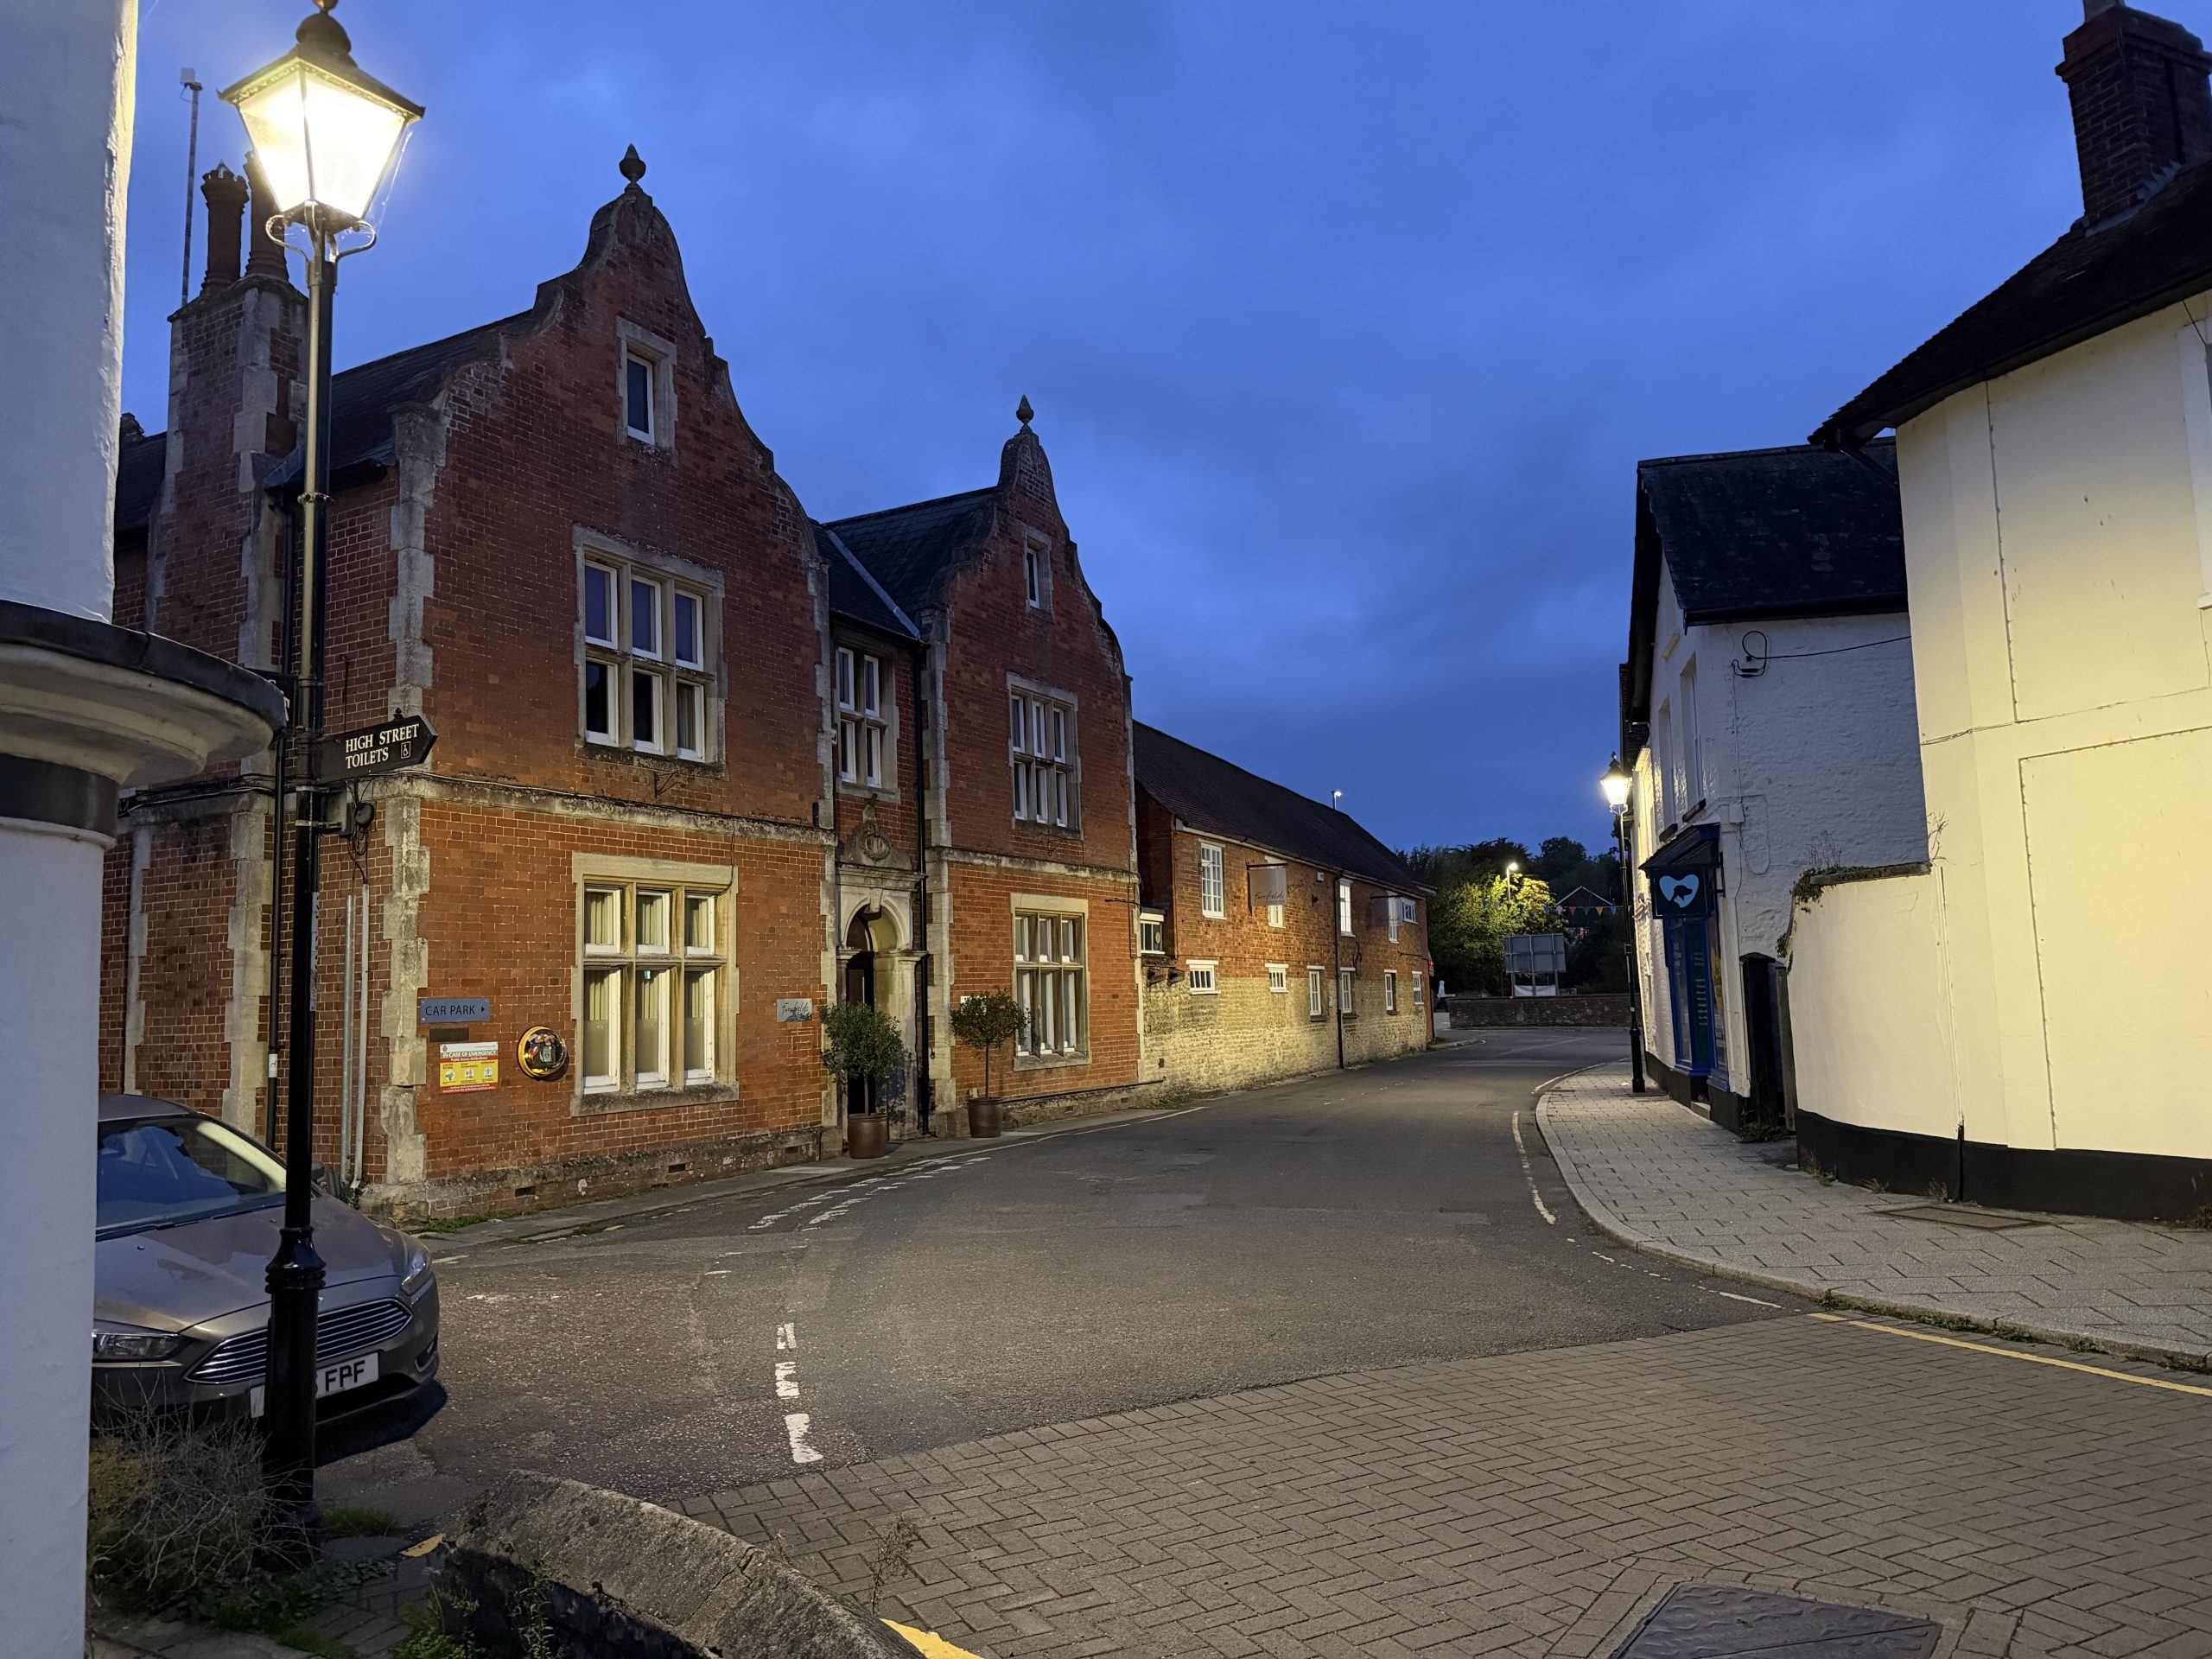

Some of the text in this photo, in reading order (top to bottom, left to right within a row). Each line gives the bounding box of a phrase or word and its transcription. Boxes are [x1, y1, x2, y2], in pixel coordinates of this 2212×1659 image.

[346, 723, 419, 753] HIGH STREET
[346, 747, 389, 769] TOILETS
[425, 1004, 475, 1016] CAR PARK
[325, 1360, 365, 1392] FPF
